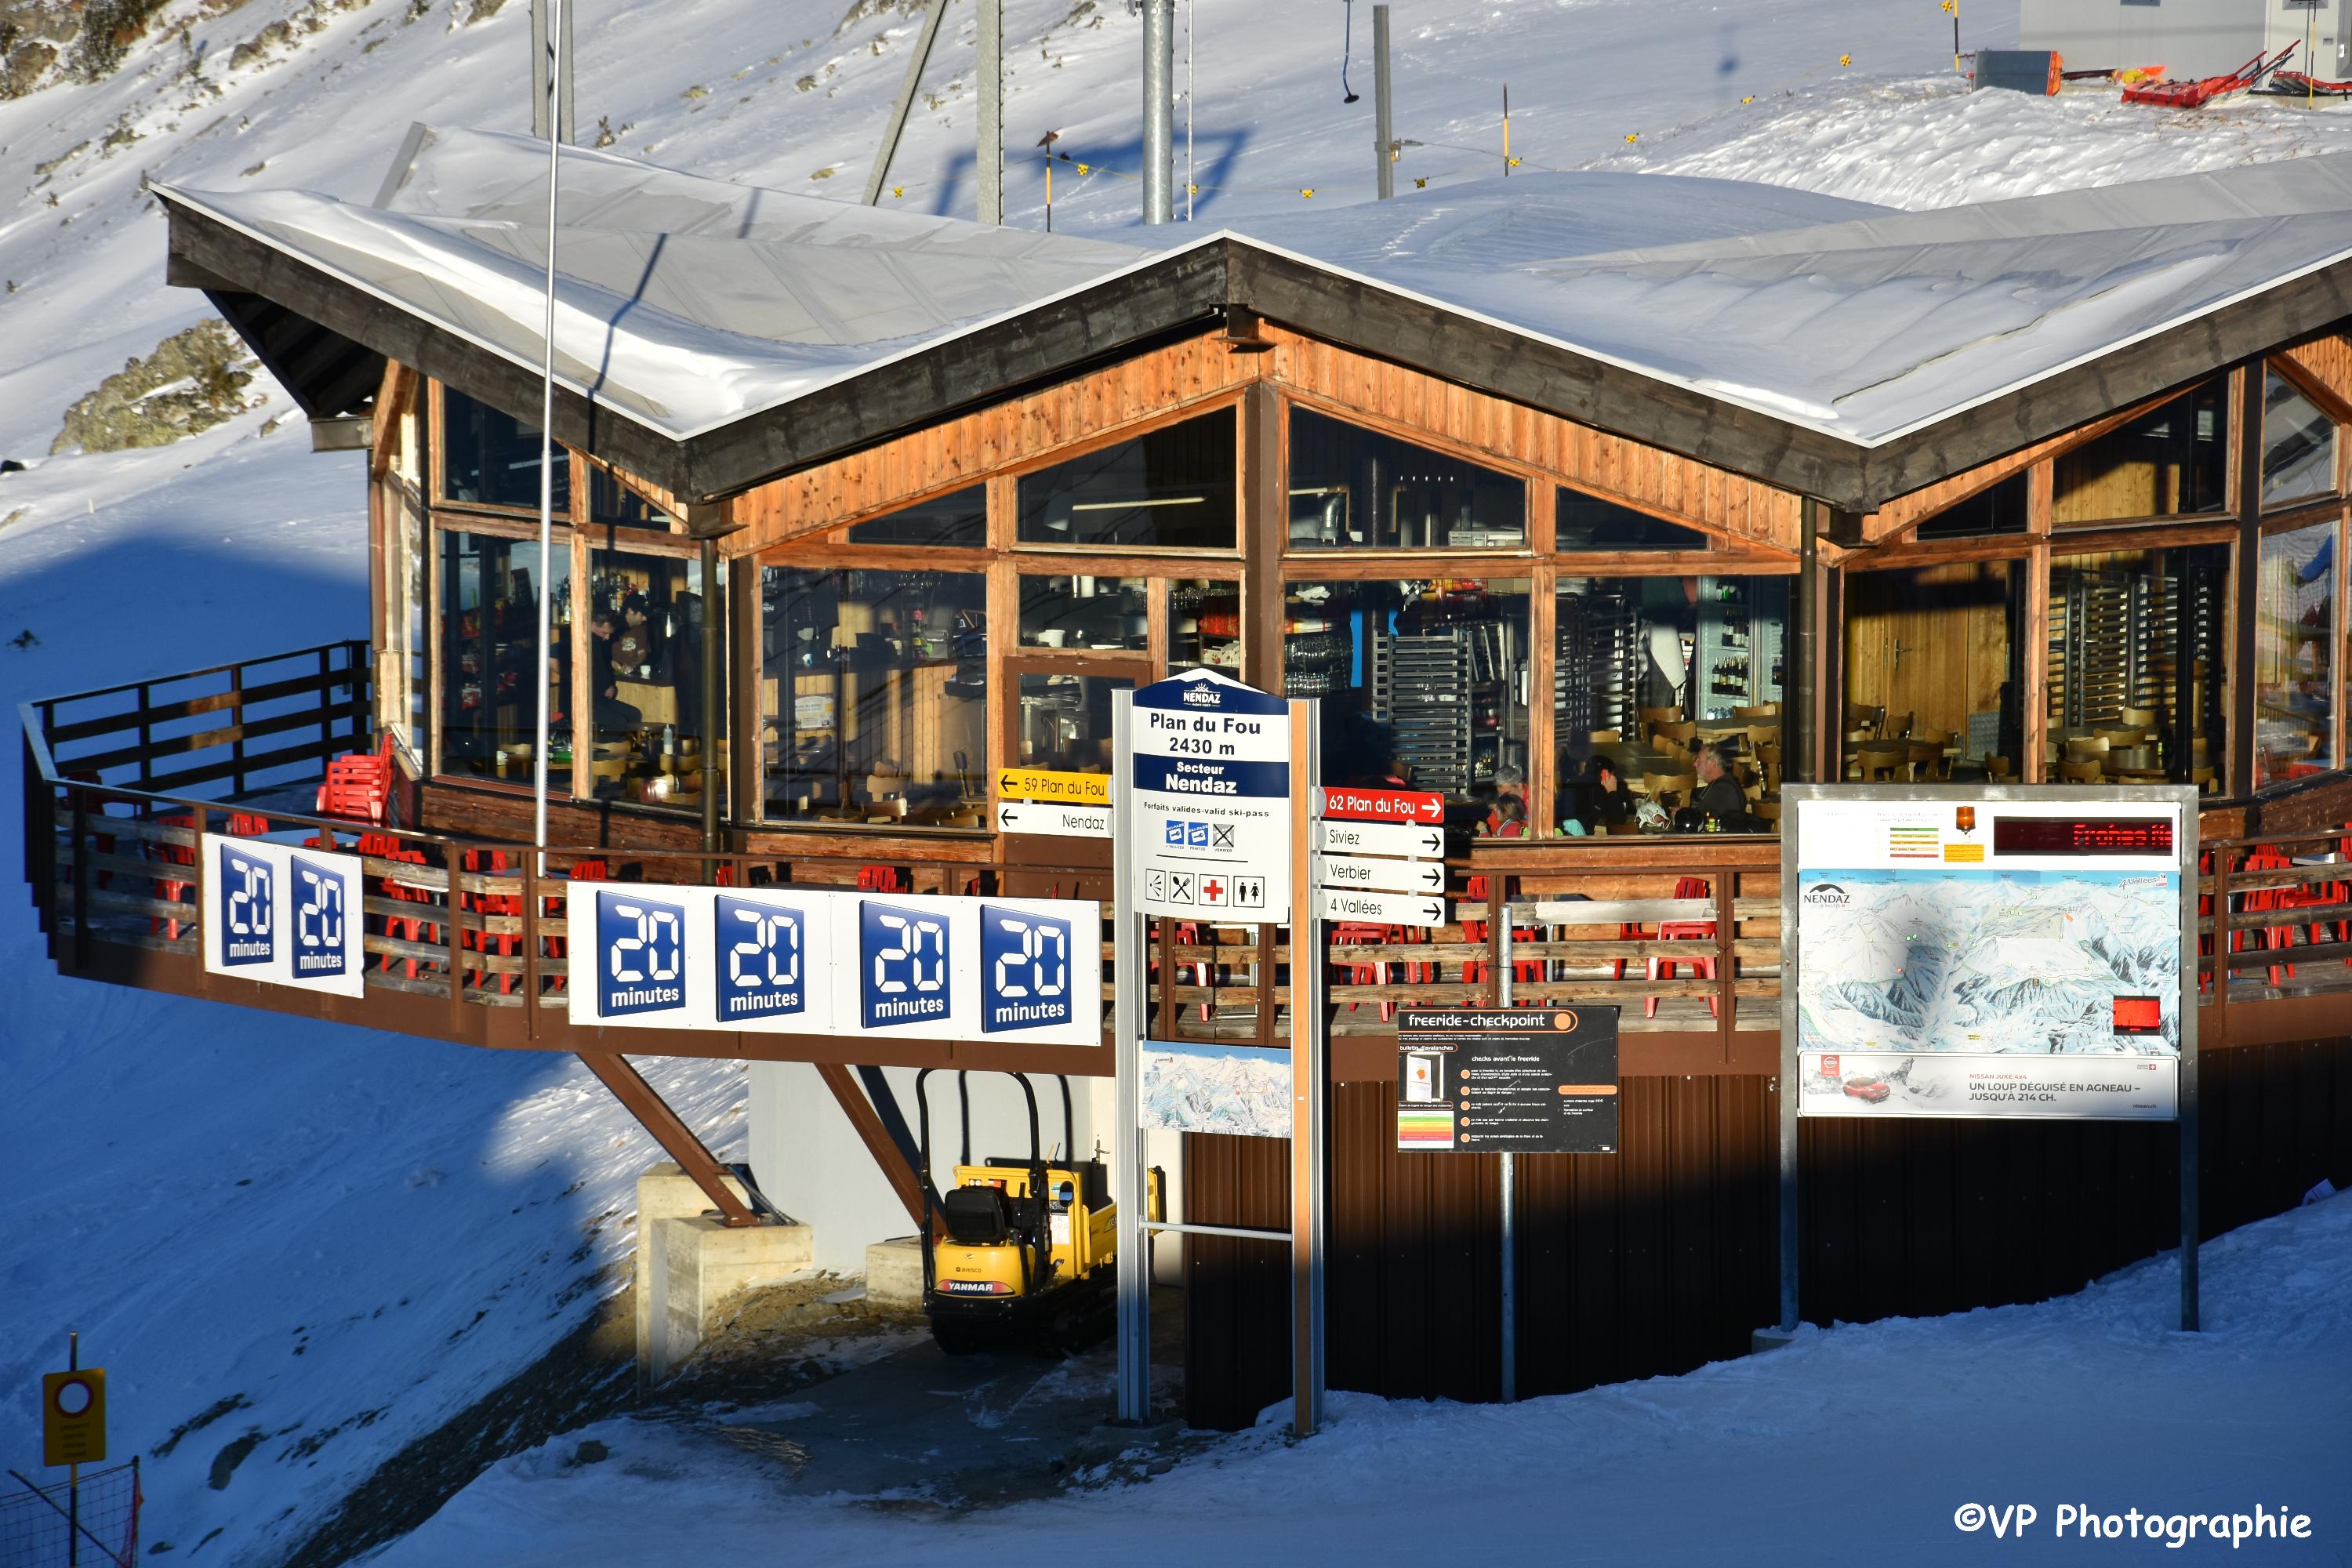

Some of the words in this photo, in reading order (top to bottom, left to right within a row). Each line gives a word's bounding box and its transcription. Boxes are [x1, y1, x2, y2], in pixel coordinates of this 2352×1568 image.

[1184, 692, 1221, 703] NENDAZ
[1151, 713, 1185, 730] Plan
[1193, 717, 1215, 732] du
[1224, 718, 1260, 734] Fou
[1170, 738, 1212, 753] 2430
[1219, 744, 1235, 755] m
[1177, 762, 1225, 775] Secteur
[1025, 778, 1038, 791] 59
[1041, 779, 1064, 793] Plan
[1068, 781, 1082, 794] du
[1086, 782, 1105, 796] Fou
[1166, 774, 1237, 793] Nendaz
[1144, 802, 1170, 811] Forfaits
[1172, 805, 1225, 815] valides-valid
[1229, 809, 1269, 818] ski-pass
[1330, 795, 1344, 810] 62
[1348, 796, 1372, 811] Plan
[1375, 798, 1391, 813] du
[1395, 799, 1415, 814] Fou
[1063, 815, 1105, 829] Nendaz
[1330, 829, 1360, 844] Siviez
[1330, 864, 1371, 880] Verbier
[229, 858, 270, 935] 20
[299, 870, 342, 946] 20
[1330, 898, 1338, 912] 4
[1341, 898, 1382, 916] Vallées
[230, 939, 270, 957] minutes
[612, 905, 679, 982] 20
[730, 909, 798, 986] 20
[300, 952, 342, 969] minutes
[875, 914, 943, 993] 20
[996, 919, 1065, 997] 20
[612, 987, 679, 1007] minutes
[730, 992, 798, 1012] minutes
[875, 997, 944, 1018] minutes
[996, 1002, 1065, 1023] minutes
[1408, 1014, 1545, 1028] freeride-checkpoint
[2020, 1081, 2067, 1091] DÉGUISÉ
[1969, 1092, 2016, 1102] JUSQU'À
[2038, 1093, 2056, 1102] CH.
[949, 1283, 993, 1291] YANMAR
